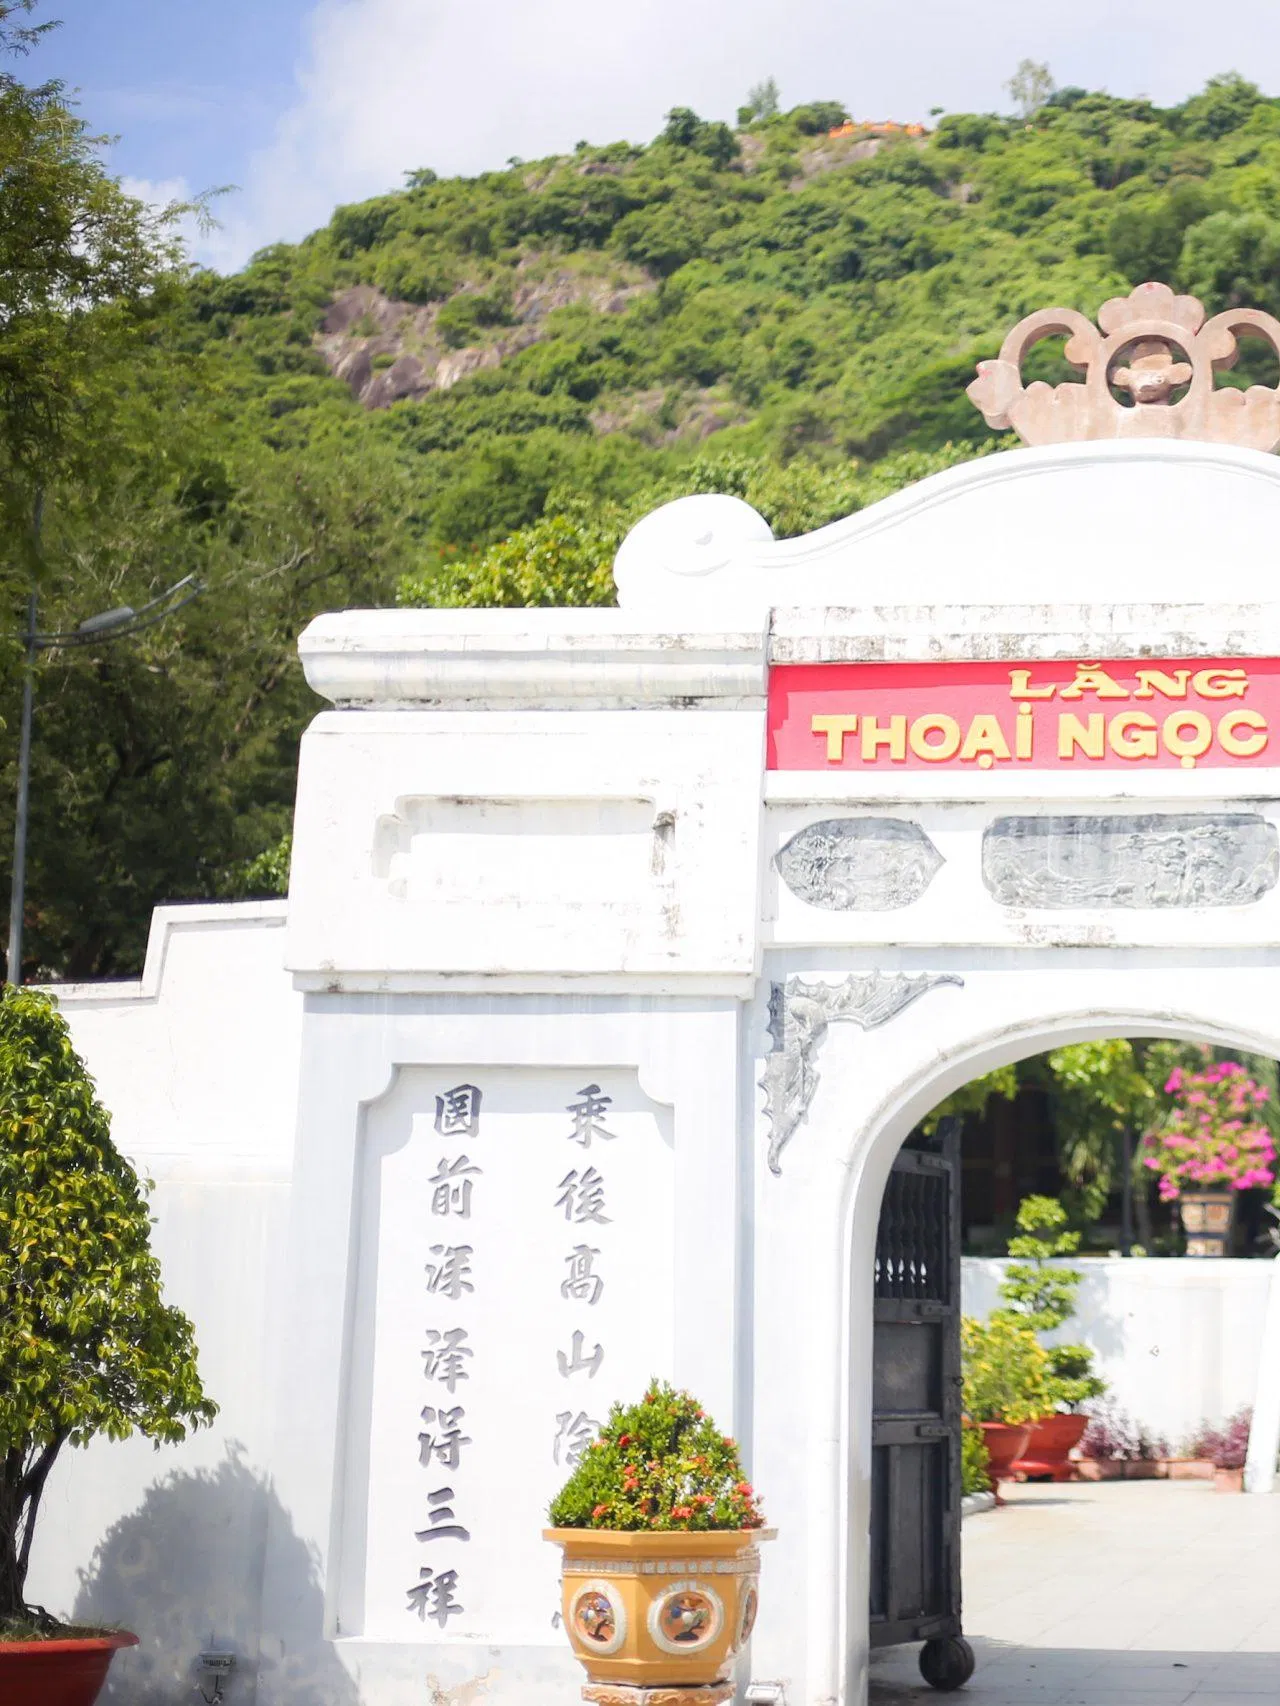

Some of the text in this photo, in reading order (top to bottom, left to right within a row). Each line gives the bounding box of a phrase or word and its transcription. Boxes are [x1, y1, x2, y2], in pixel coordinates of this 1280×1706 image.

[1008, 663, 1249, 699] LĂNG
[811, 701, 1034, 769] THOẠI
[1058, 709, 1268, 769] NGỌC
